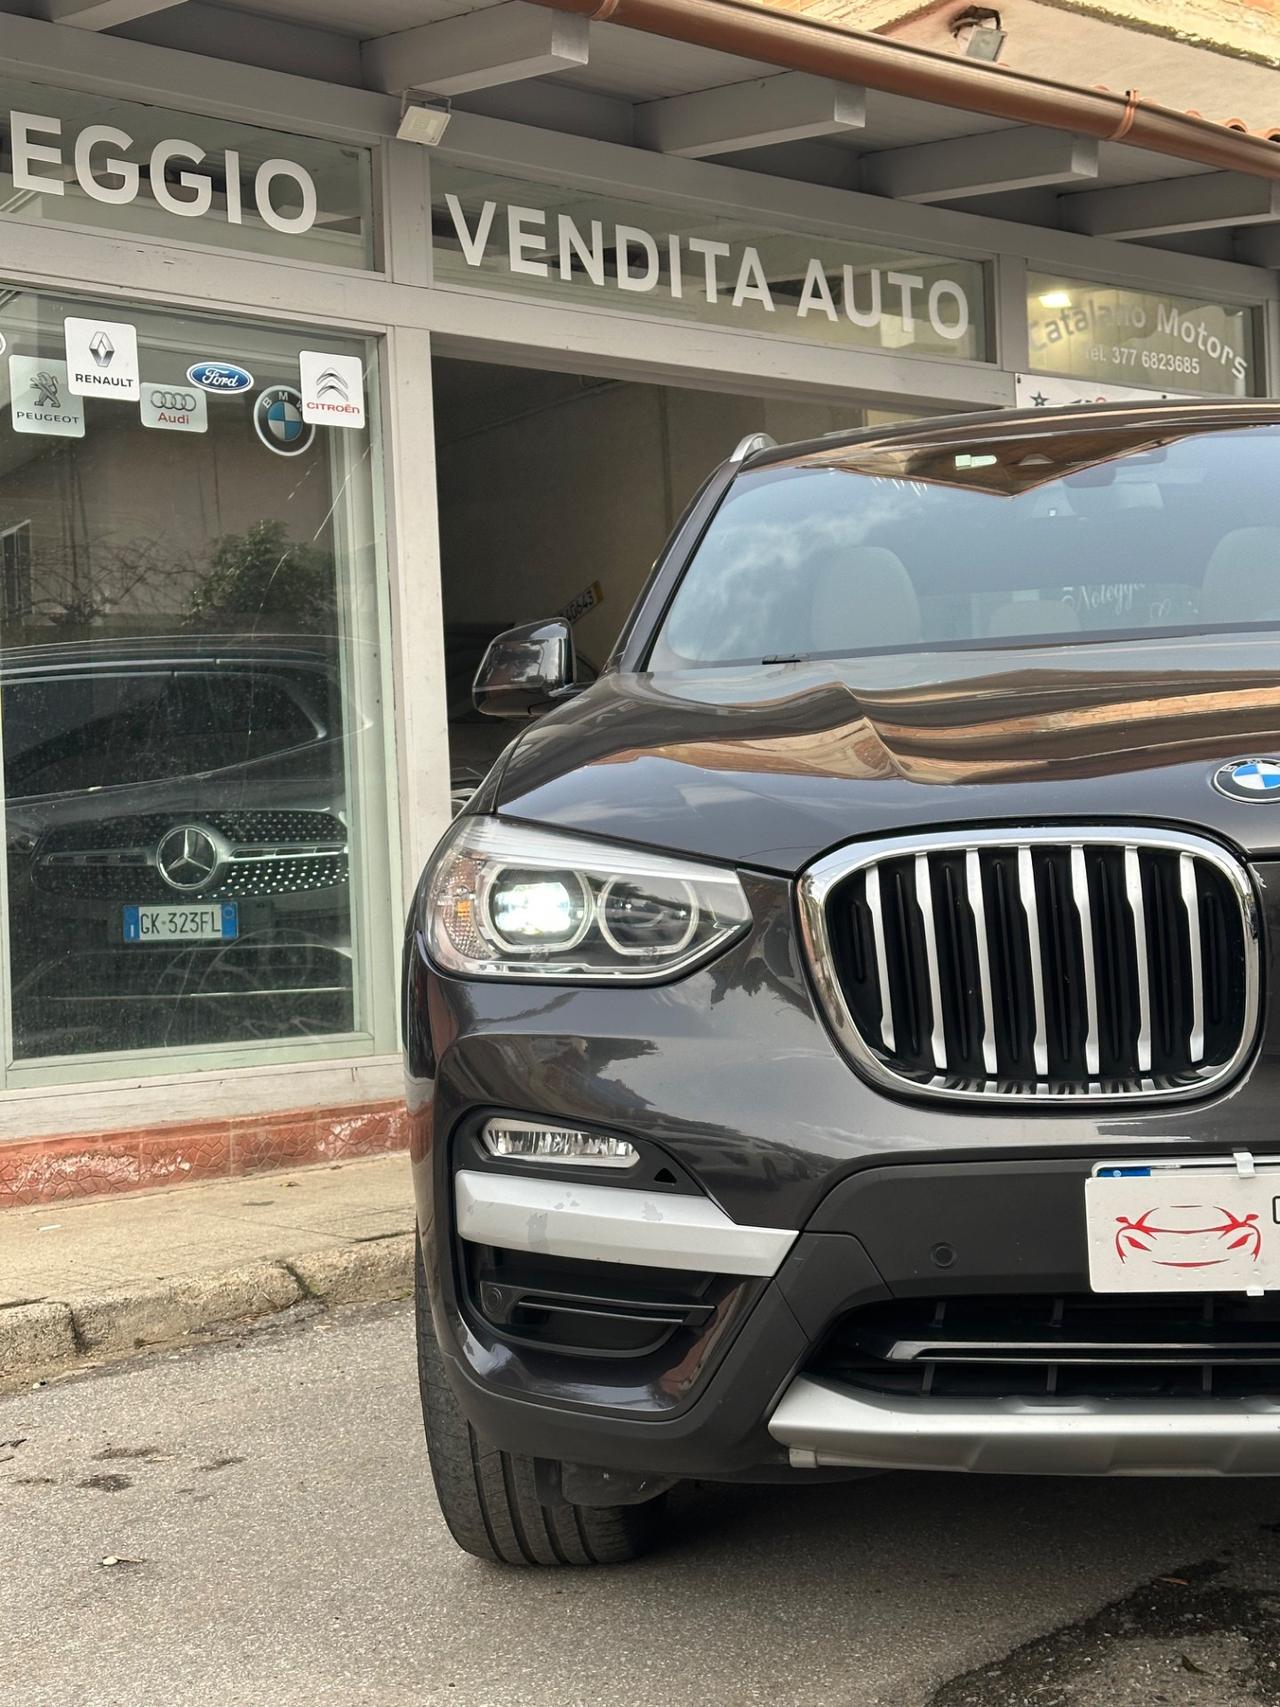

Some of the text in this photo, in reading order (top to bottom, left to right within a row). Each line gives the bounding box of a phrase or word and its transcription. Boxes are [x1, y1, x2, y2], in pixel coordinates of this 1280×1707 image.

[10, 111, 317, 234] EGGIO
[445, 194, 969, 340] VENDITA AUTO
[1157, 303, 1248, 380] Motors
[1112, 346, 1137, 366] 377
[1142, 351, 1200, 375] 6823685
[75, 373, 134, 388] RENAULT
[202, 367, 239, 387] Ford
[16, 411, 80, 424] PEUGEOT
[158, 412, 190, 425] Audi
